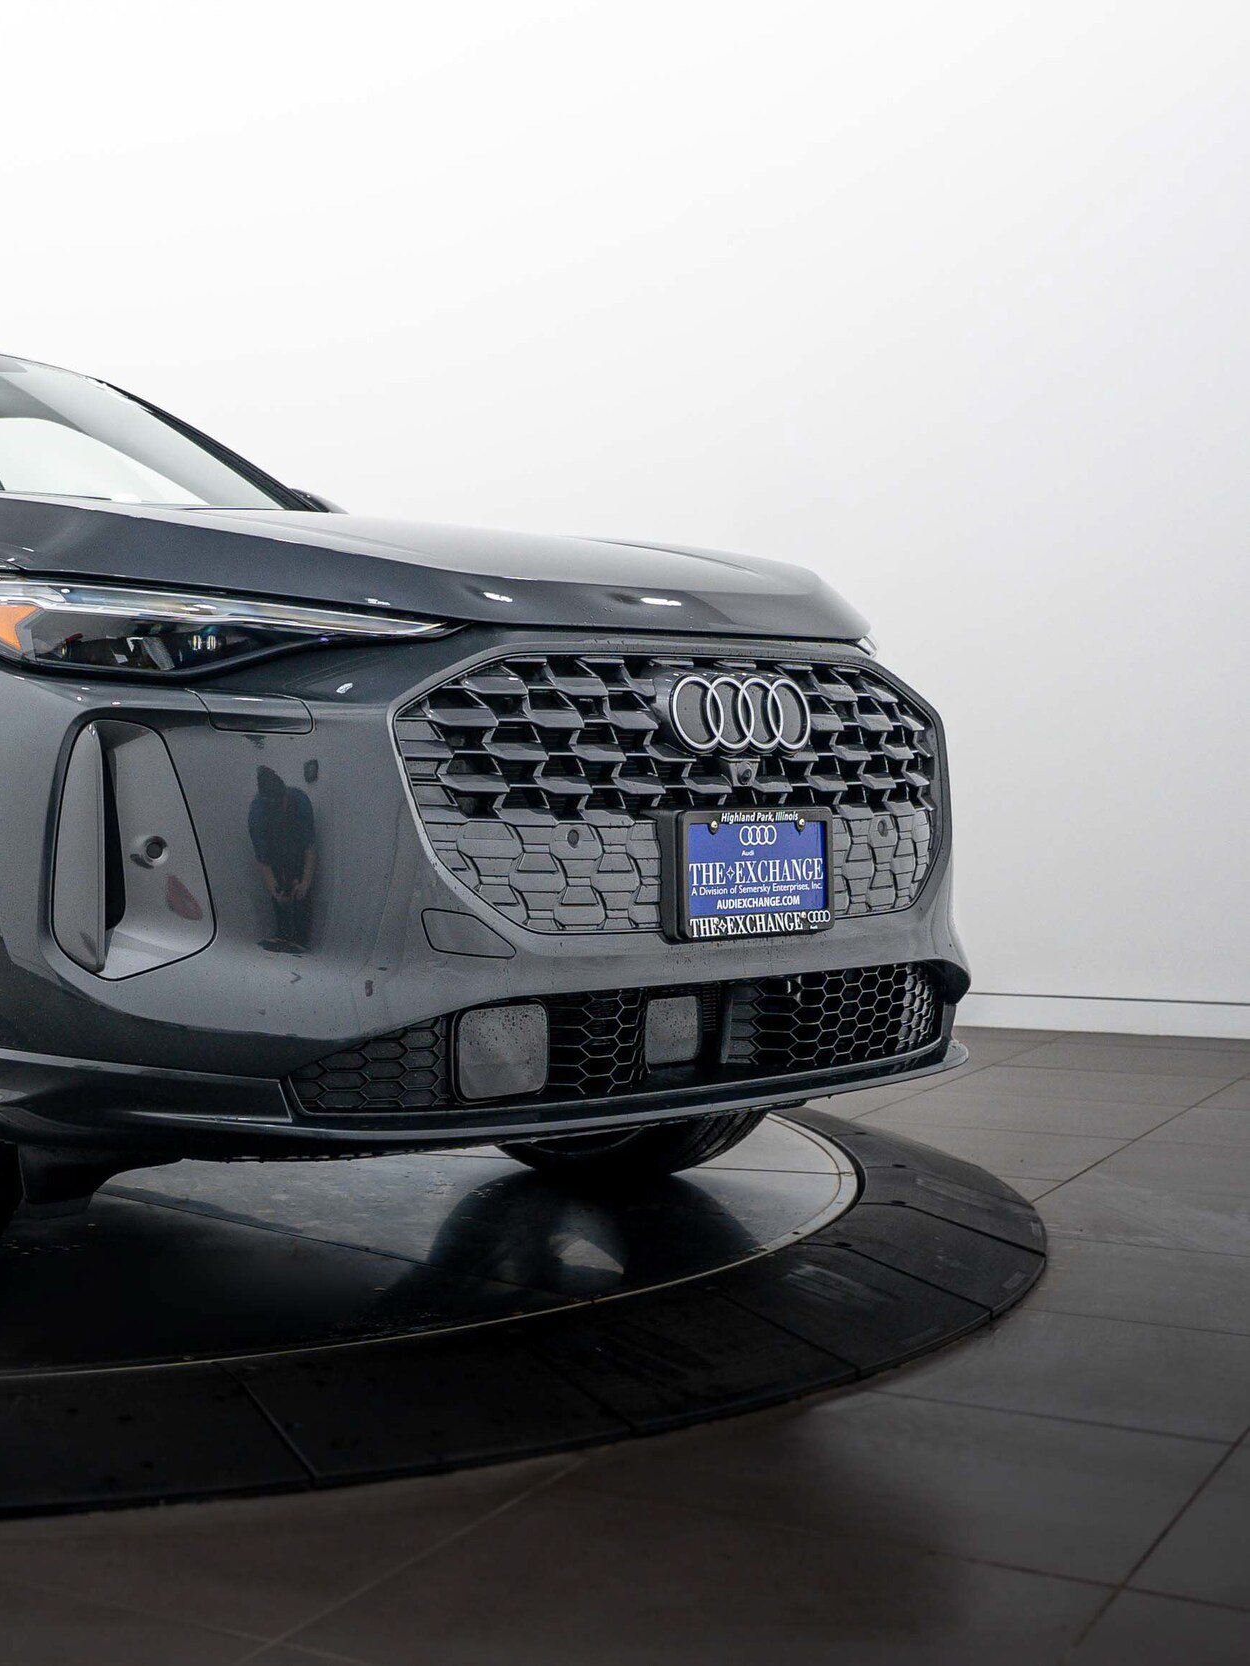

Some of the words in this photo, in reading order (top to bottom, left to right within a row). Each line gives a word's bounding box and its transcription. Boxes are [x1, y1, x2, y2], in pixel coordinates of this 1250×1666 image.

[721, 812, 755, 824] Highland
[756, 812, 775, 822] Park,
[775, 811, 799, 821] Illinois
[689, 862, 726, 886] THE
[735, 858, 823, 884] EXCHANGE
[699, 886, 728, 896] Division
[729, 886, 738, 894] of
[738, 885, 771, 896] Semersky
[811, 881, 823, 890] Inc.
[716, 895, 801, 909] AUDIEXCHANGE.COM
[690, 917, 721, 938] THE
[726, 911, 803, 935] EXCHANGE
